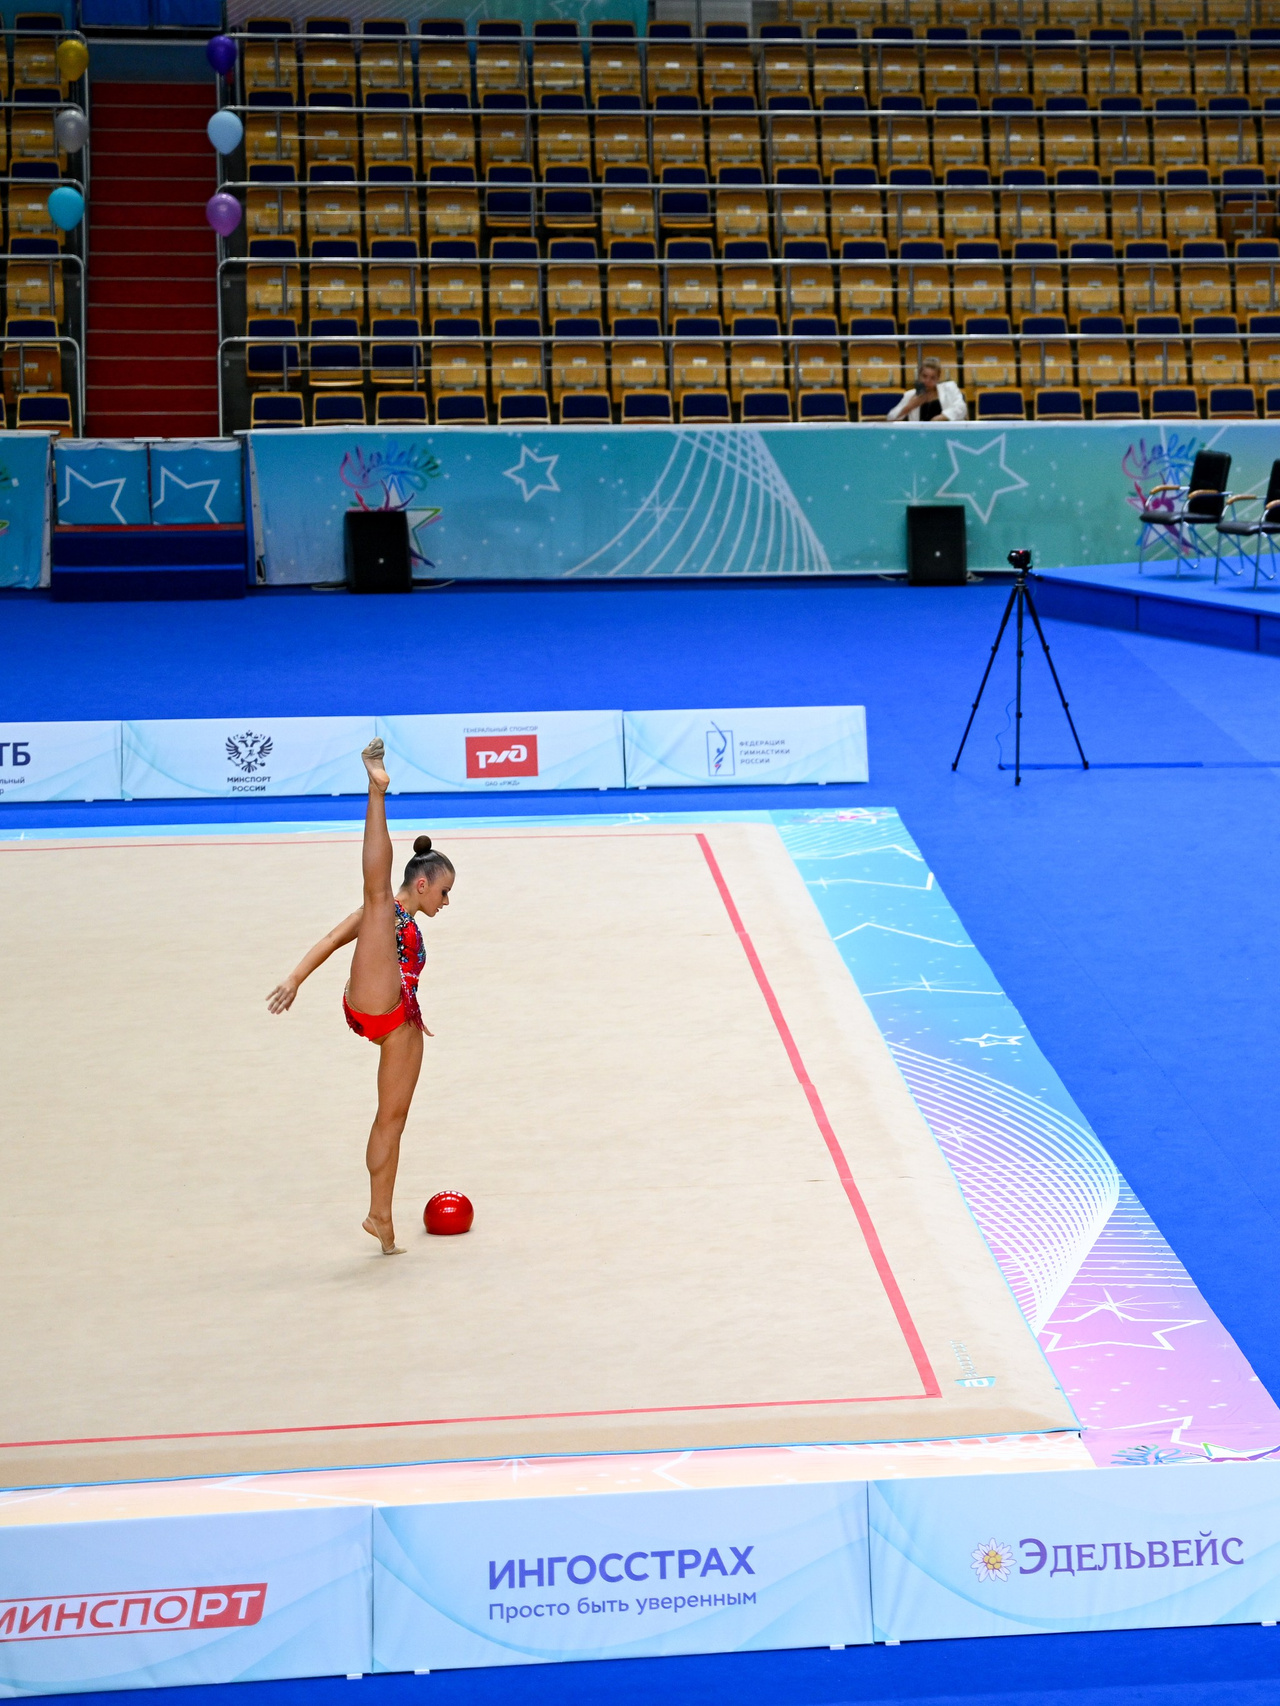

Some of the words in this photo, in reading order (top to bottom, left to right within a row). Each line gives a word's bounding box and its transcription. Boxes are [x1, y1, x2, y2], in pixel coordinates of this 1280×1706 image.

[740, 748, 791, 756] ГИМНАСТИКИ
[489, 1545, 756, 1591] ИНГОССТРАХ
[489, 1602, 570, 1623] Просто
[577, 1596, 630, 1615] быть
[636, 1591, 757, 1615] уверенным
